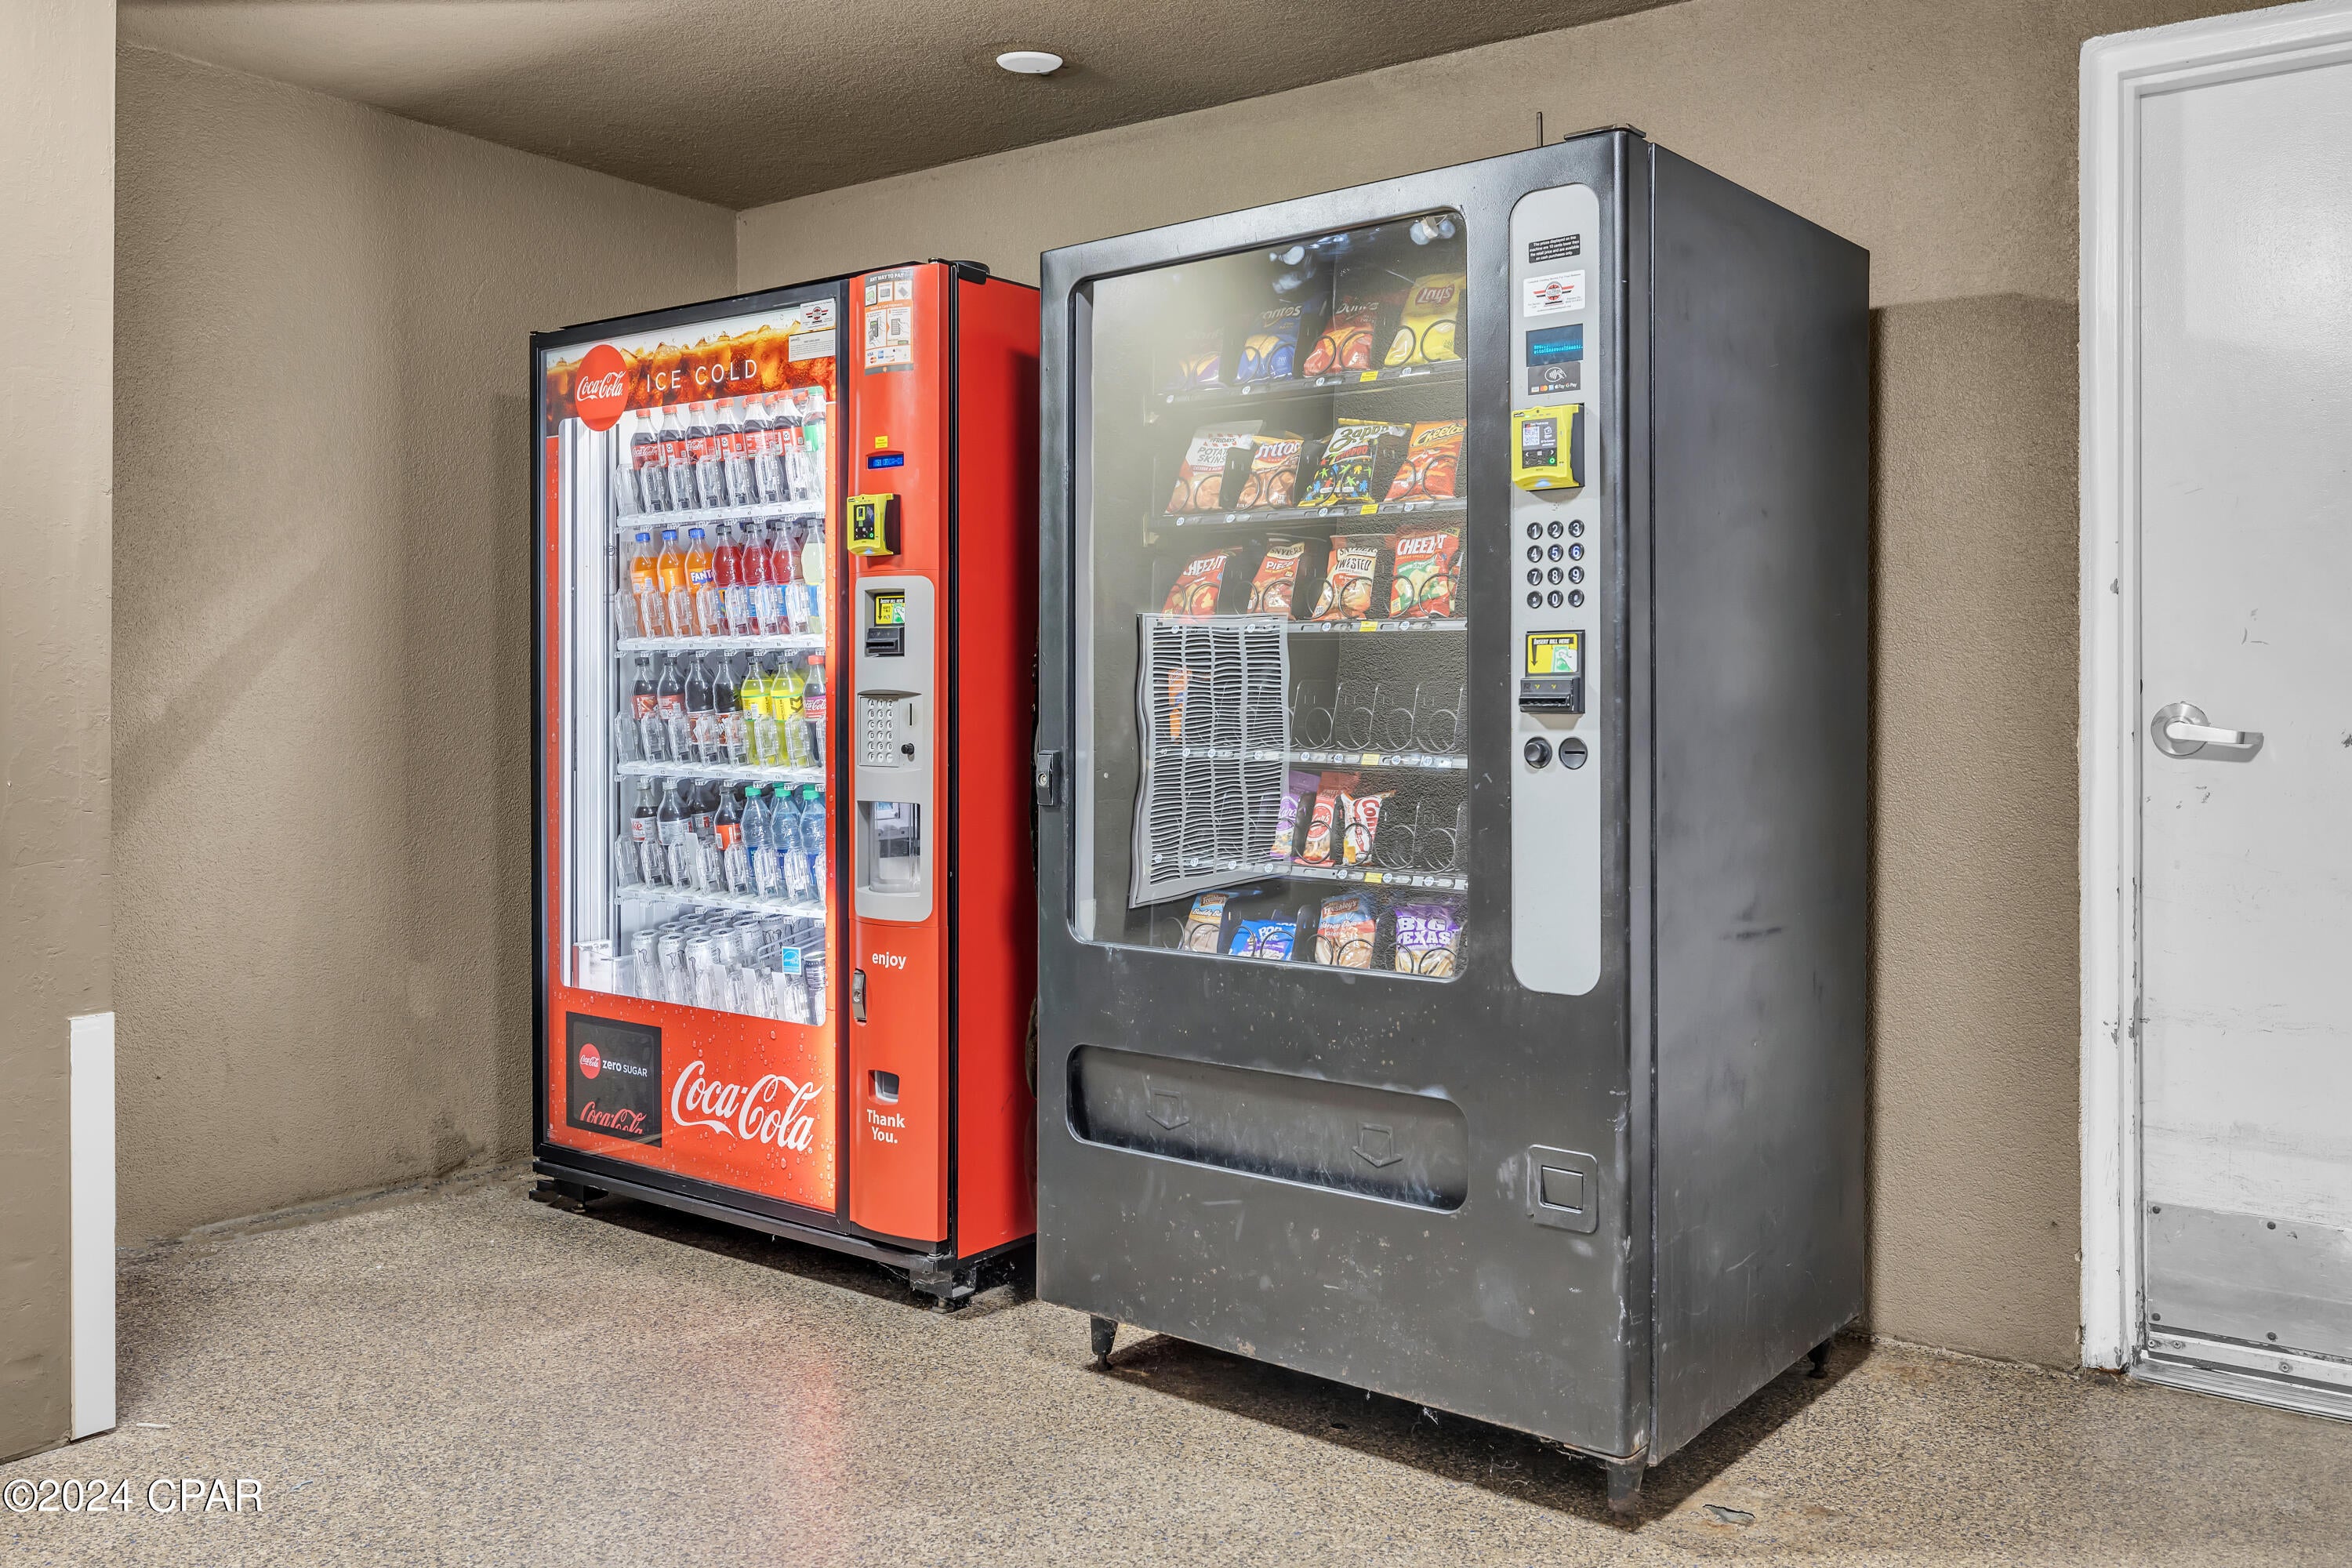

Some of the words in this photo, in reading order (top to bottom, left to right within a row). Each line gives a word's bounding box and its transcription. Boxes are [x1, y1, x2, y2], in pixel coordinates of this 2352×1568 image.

[1261, 305, 1302, 320] oritos
[647, 369, 681, 392] ICE
[695, 359, 758, 386] COLD
[576, 369, 626, 401] Coca-Cola
[1198, 447, 1228, 456] POTAT
[1198, 456, 1225, 464] SKINS
[1532, 525, 1537, 535] 1
[1552, 524, 1558, 535] 2
[1573, 523, 1580, 533] 3
[1531, 549, 1537, 558] 4
[1552, 547, 1558, 557] 5
[1573, 546, 1580, 557] 6
[1532, 572, 1537, 582] 7
[1552, 571, 1558, 580] 8
[1572, 569, 1579, 580] 9
[1552, 593, 1558, 604] 0
[1192, 908, 1212, 917] Buddy
[1323, 901, 1357, 915] Freshley's
[1398, 917, 1446, 931] BIG
[1398, 931, 1450, 944] TEXAS
[872, 952, 907, 970] enjoy
[580, 1054, 600, 1068] Coca-Cola
[602, 1060, 622, 1072] zero
[622, 1065, 648, 1077] SUGAR
[671, 1060, 825, 1152] Coca-Cola
[866, 1109, 906, 1128] Thank
[871, 1126, 898, 1143] You.
